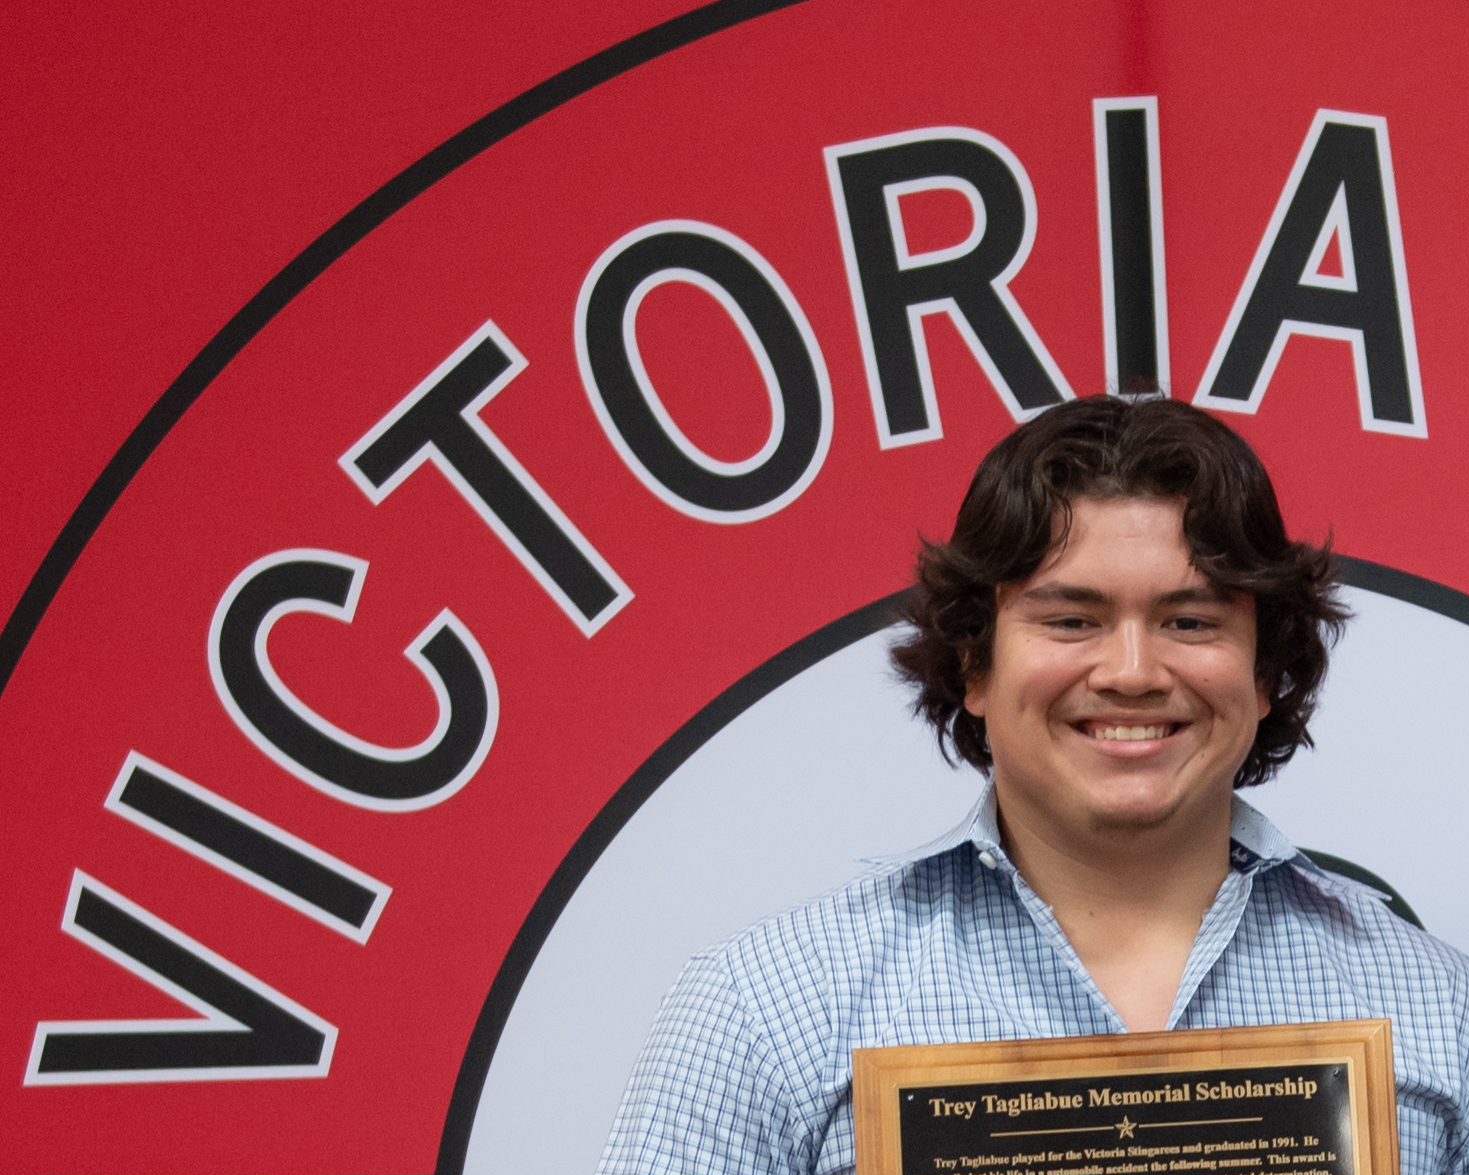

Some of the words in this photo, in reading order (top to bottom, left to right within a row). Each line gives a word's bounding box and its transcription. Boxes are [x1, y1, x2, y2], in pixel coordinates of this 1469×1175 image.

[23, 95, 1429, 1087] VICTORIA
[929, 1098, 977, 1120] Trey
[981, 1091, 1083, 1116] Tagliabue
[1088, 1083, 1190, 1107] Memorial
[1195, 1076, 1318, 1101] Scholarship
[934, 1158, 957, 1169] Trey
[959, 1155, 1009, 1169] Tagliabue
[1011, 1152, 1046, 1166] played
[1047, 1151, 1064, 1162] for
[1065, 1150, 1082, 1161] the
[1084, 1147, 1126, 1160] Victoria
[1127, 1145, 1181, 1158] Stingarees
[1181, 1143, 1202, 1154] and
[1204, 1140, 1257, 1155] graduated
[1258, 1138, 1269, 1149] in
[1271, 1138, 1299, 1149] 1991.
[1303, 1136, 1319, 1147] He
[1105, 1162, 1149, 1175] accident
[1150, 1161, 1168, 1172] the
[1169, 1158, 1217, 1171] following
[1218, 1157, 1263, 1168] summer.
[1267, 1153, 1291, 1165] This
[1292, 1152, 1326, 1163] award
[1327, 1151, 1337, 1162] is
